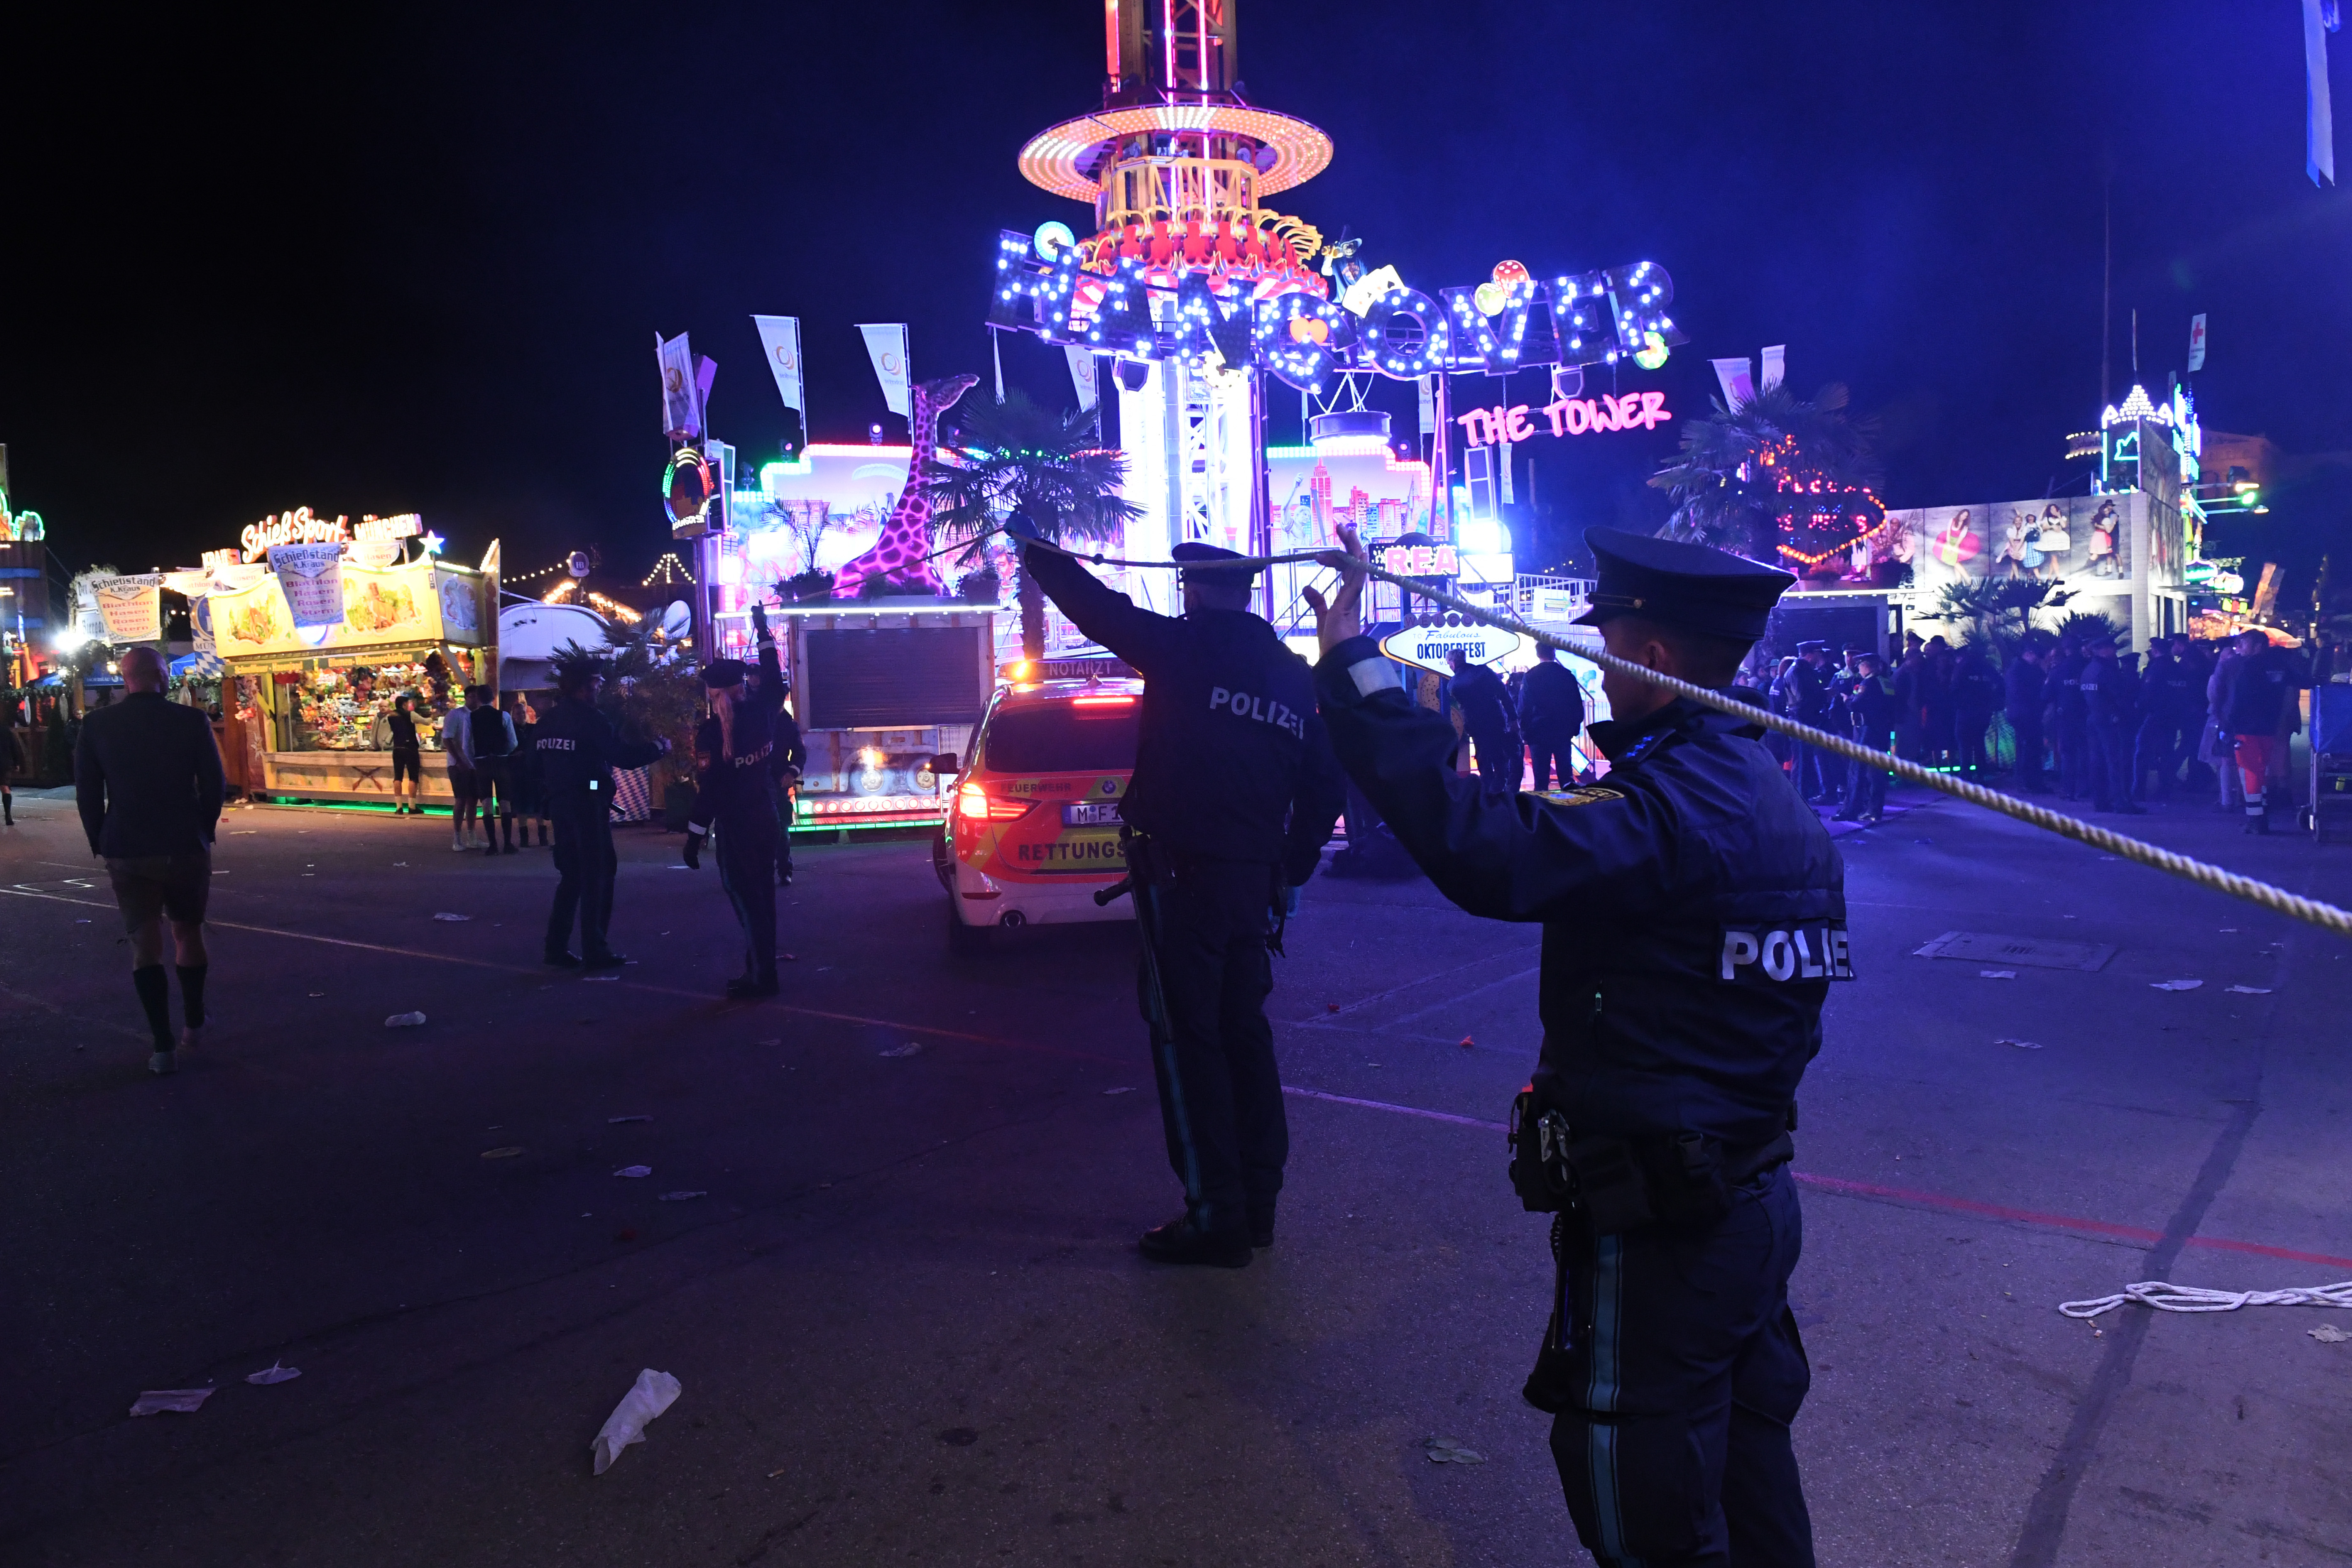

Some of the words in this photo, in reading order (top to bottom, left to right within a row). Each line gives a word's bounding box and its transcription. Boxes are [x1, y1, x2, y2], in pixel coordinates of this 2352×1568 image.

[985, 229, 1689, 394] HANGOVER
[1457, 408, 1534, 447] THE
[1543, 392, 1671, 437] TOWER
[241, 511, 292, 563] Schieß
[293, 506, 346, 544] Sport
[354, 514, 417, 540] MÜNCHEN
[274, 550, 340, 568] Schießstand
[91, 577, 155, 592] Schießstand
[286, 579, 338, 588] Biathlon
[294, 589, 334, 597] Hasen
[103, 600, 153, 609] Biathlon
[1405, 616, 1486, 626] WELCO
[1425, 630, 1481, 640] Fabulous
[1049, 661, 1112, 676] NOTARZT
[1209, 686, 1304, 740] POLIZEI
[537, 738, 575, 751] POLIZEI
[1001, 782, 1071, 792] FEUERWEHR
[1018, 841, 1126, 861] RETTUNGS
